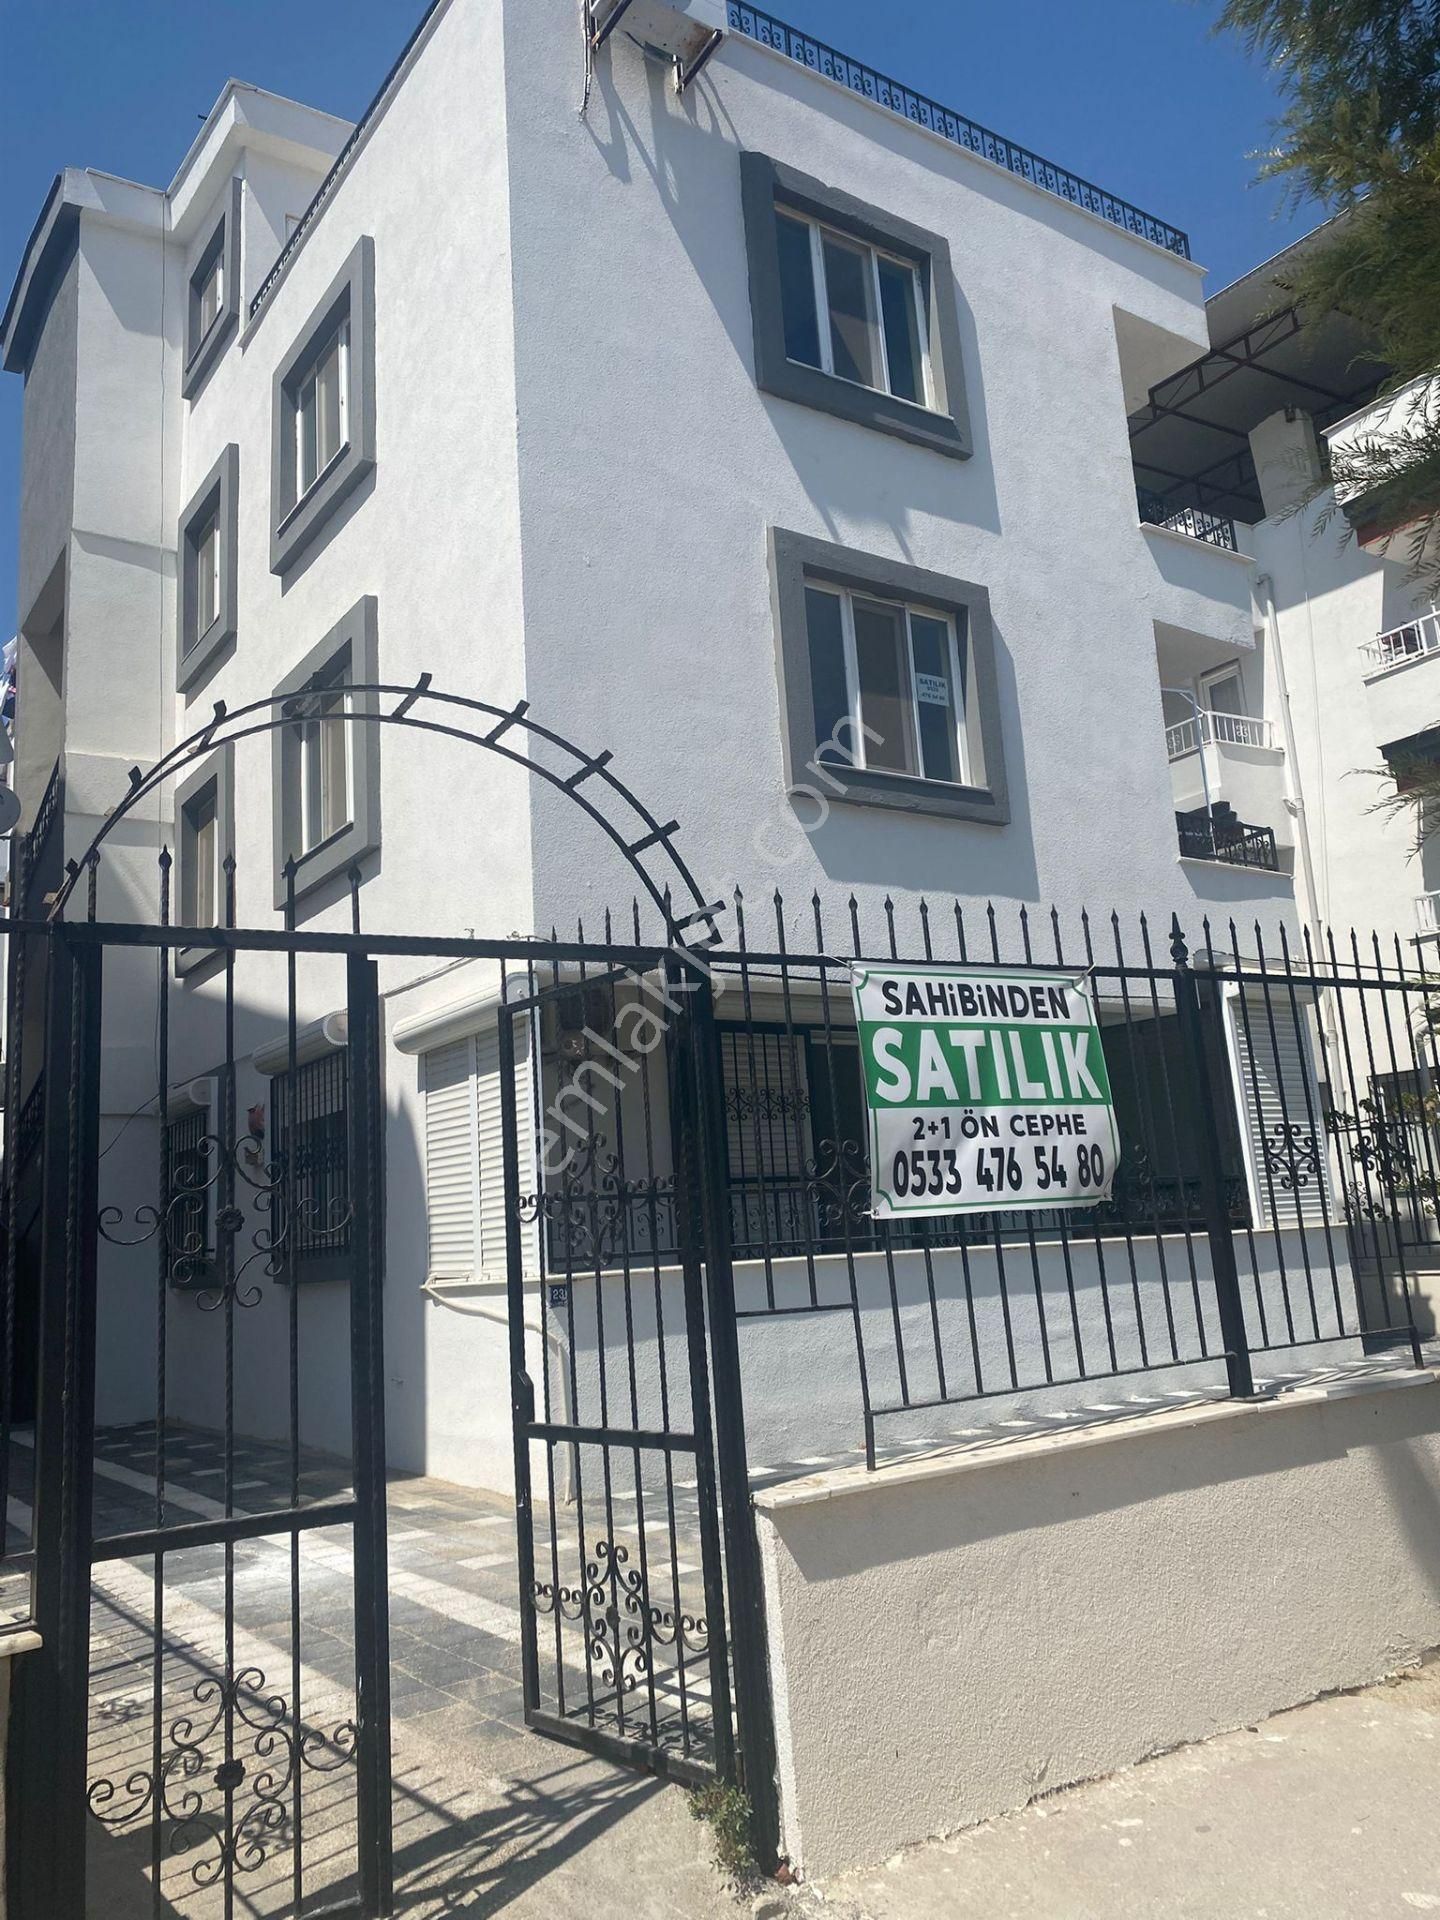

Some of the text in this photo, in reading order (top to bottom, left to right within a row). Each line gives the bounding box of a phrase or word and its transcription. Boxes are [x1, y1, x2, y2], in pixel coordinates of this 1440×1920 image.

[872, 1027, 1104, 1103] SATILIK
[912, 1109, 1087, 1140] 2+1 ÖN CEPHE
[893, 1143, 1104, 1198] 0533 476 54 80
